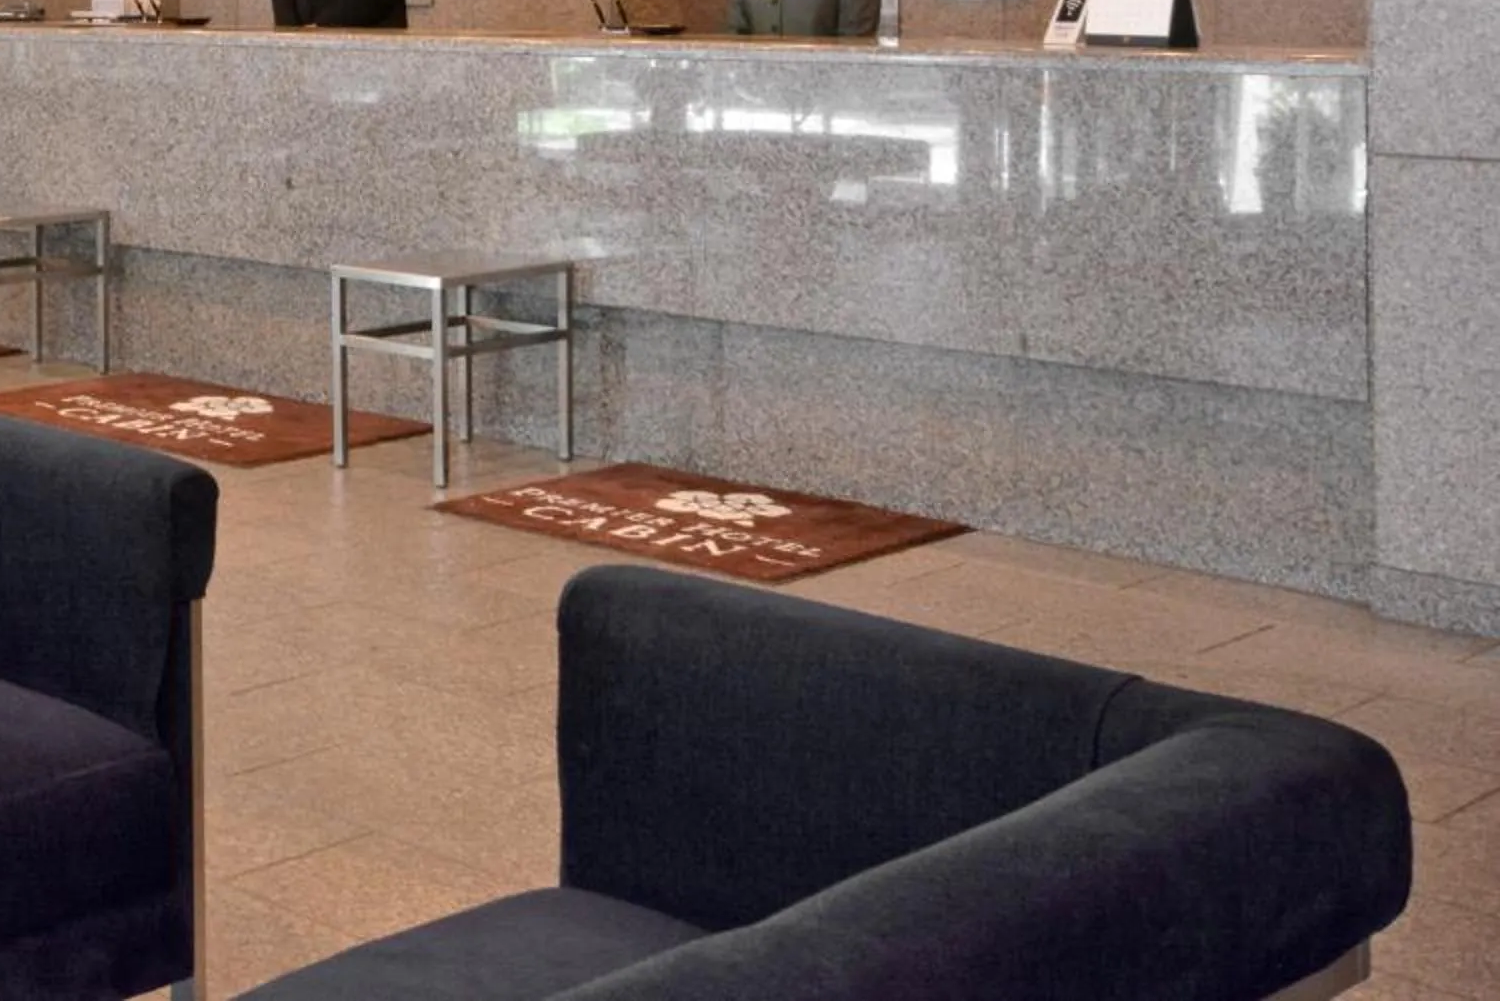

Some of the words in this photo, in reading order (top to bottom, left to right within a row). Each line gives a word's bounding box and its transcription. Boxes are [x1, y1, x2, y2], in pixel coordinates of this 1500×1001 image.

[509, 487, 675, 526] PREMIER
[680, 522, 821, 558] HOTEL
[523, 506, 747, 556] CABIN
